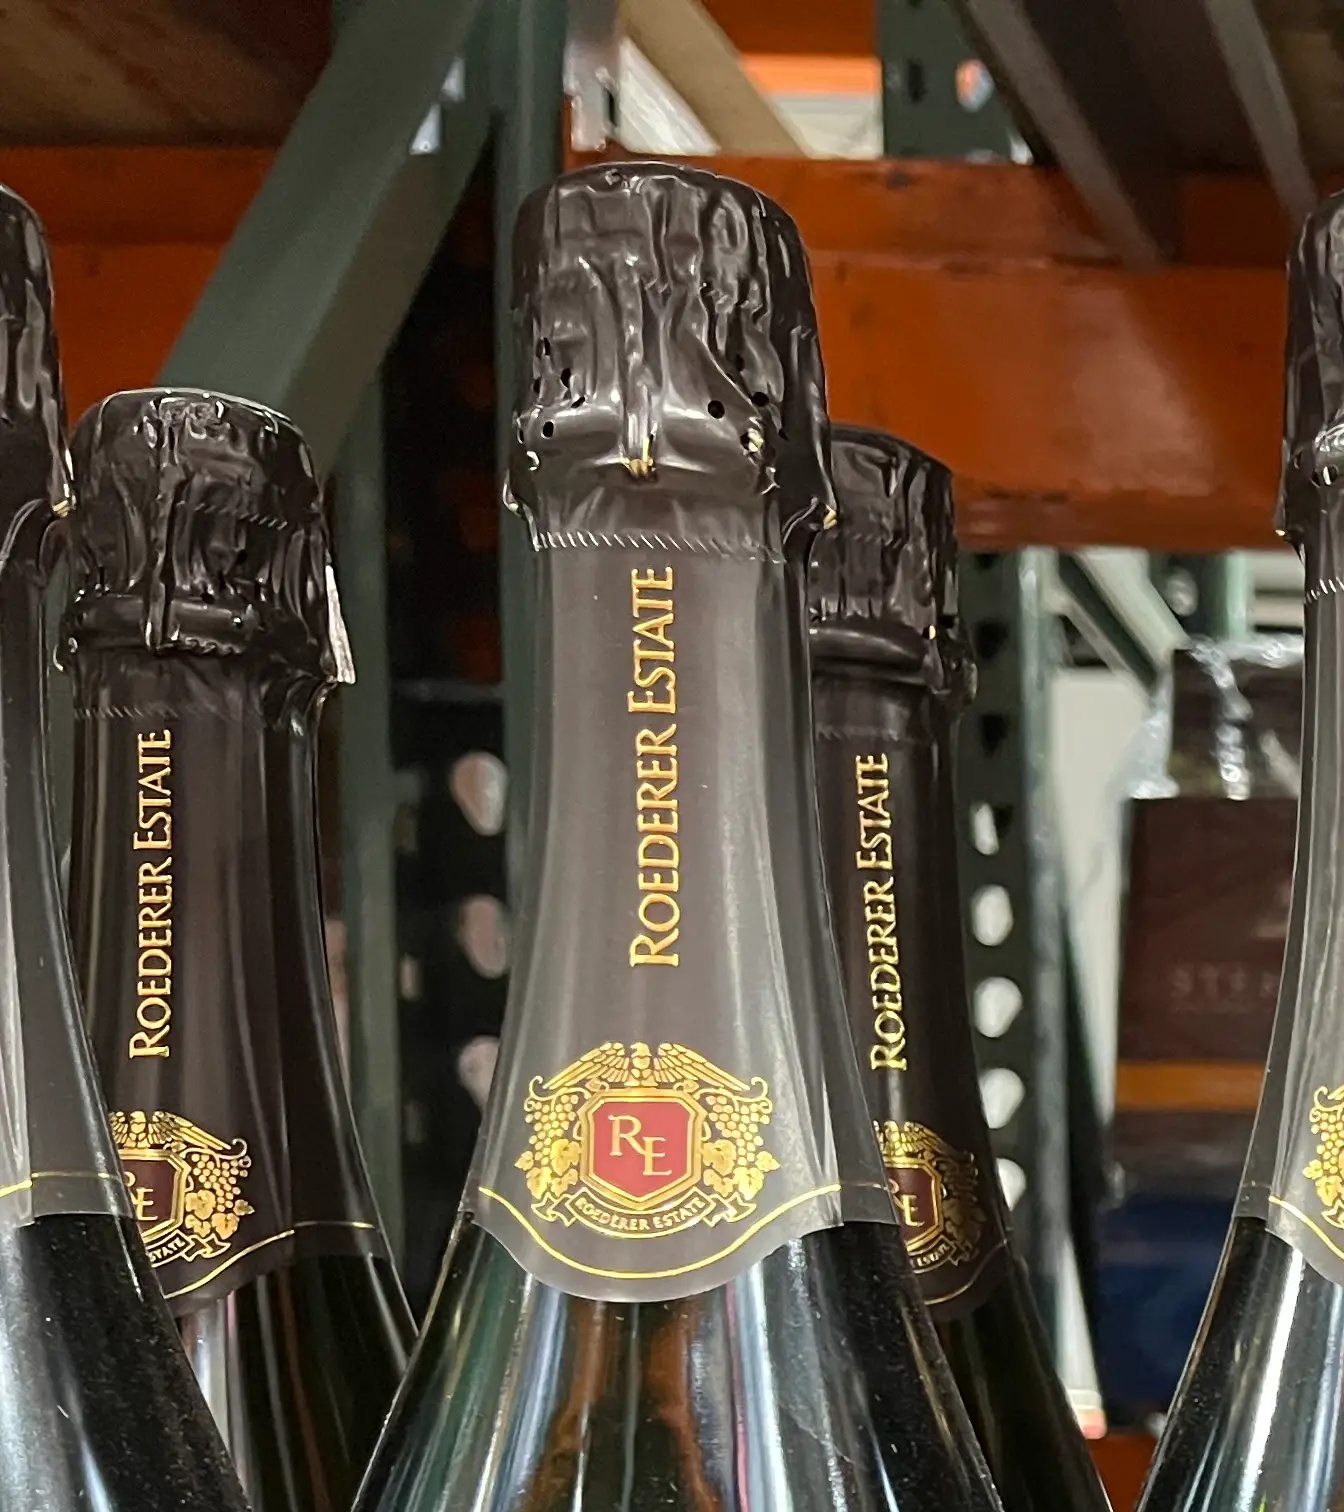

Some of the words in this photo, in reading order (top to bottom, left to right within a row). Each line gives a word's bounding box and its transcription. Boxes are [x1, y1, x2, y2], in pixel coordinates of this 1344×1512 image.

[627, 566, 676, 714] ESTATE
[133, 729, 172, 850] ESTATE
[629, 723, 680, 968] ROEDERER
[856, 753, 893, 871] ESTATE
[129, 856, 173, 1059] ROEDERER
[863, 876, 907, 1072] ROEDERER
[653, 1199, 706, 1228] ESTATE
